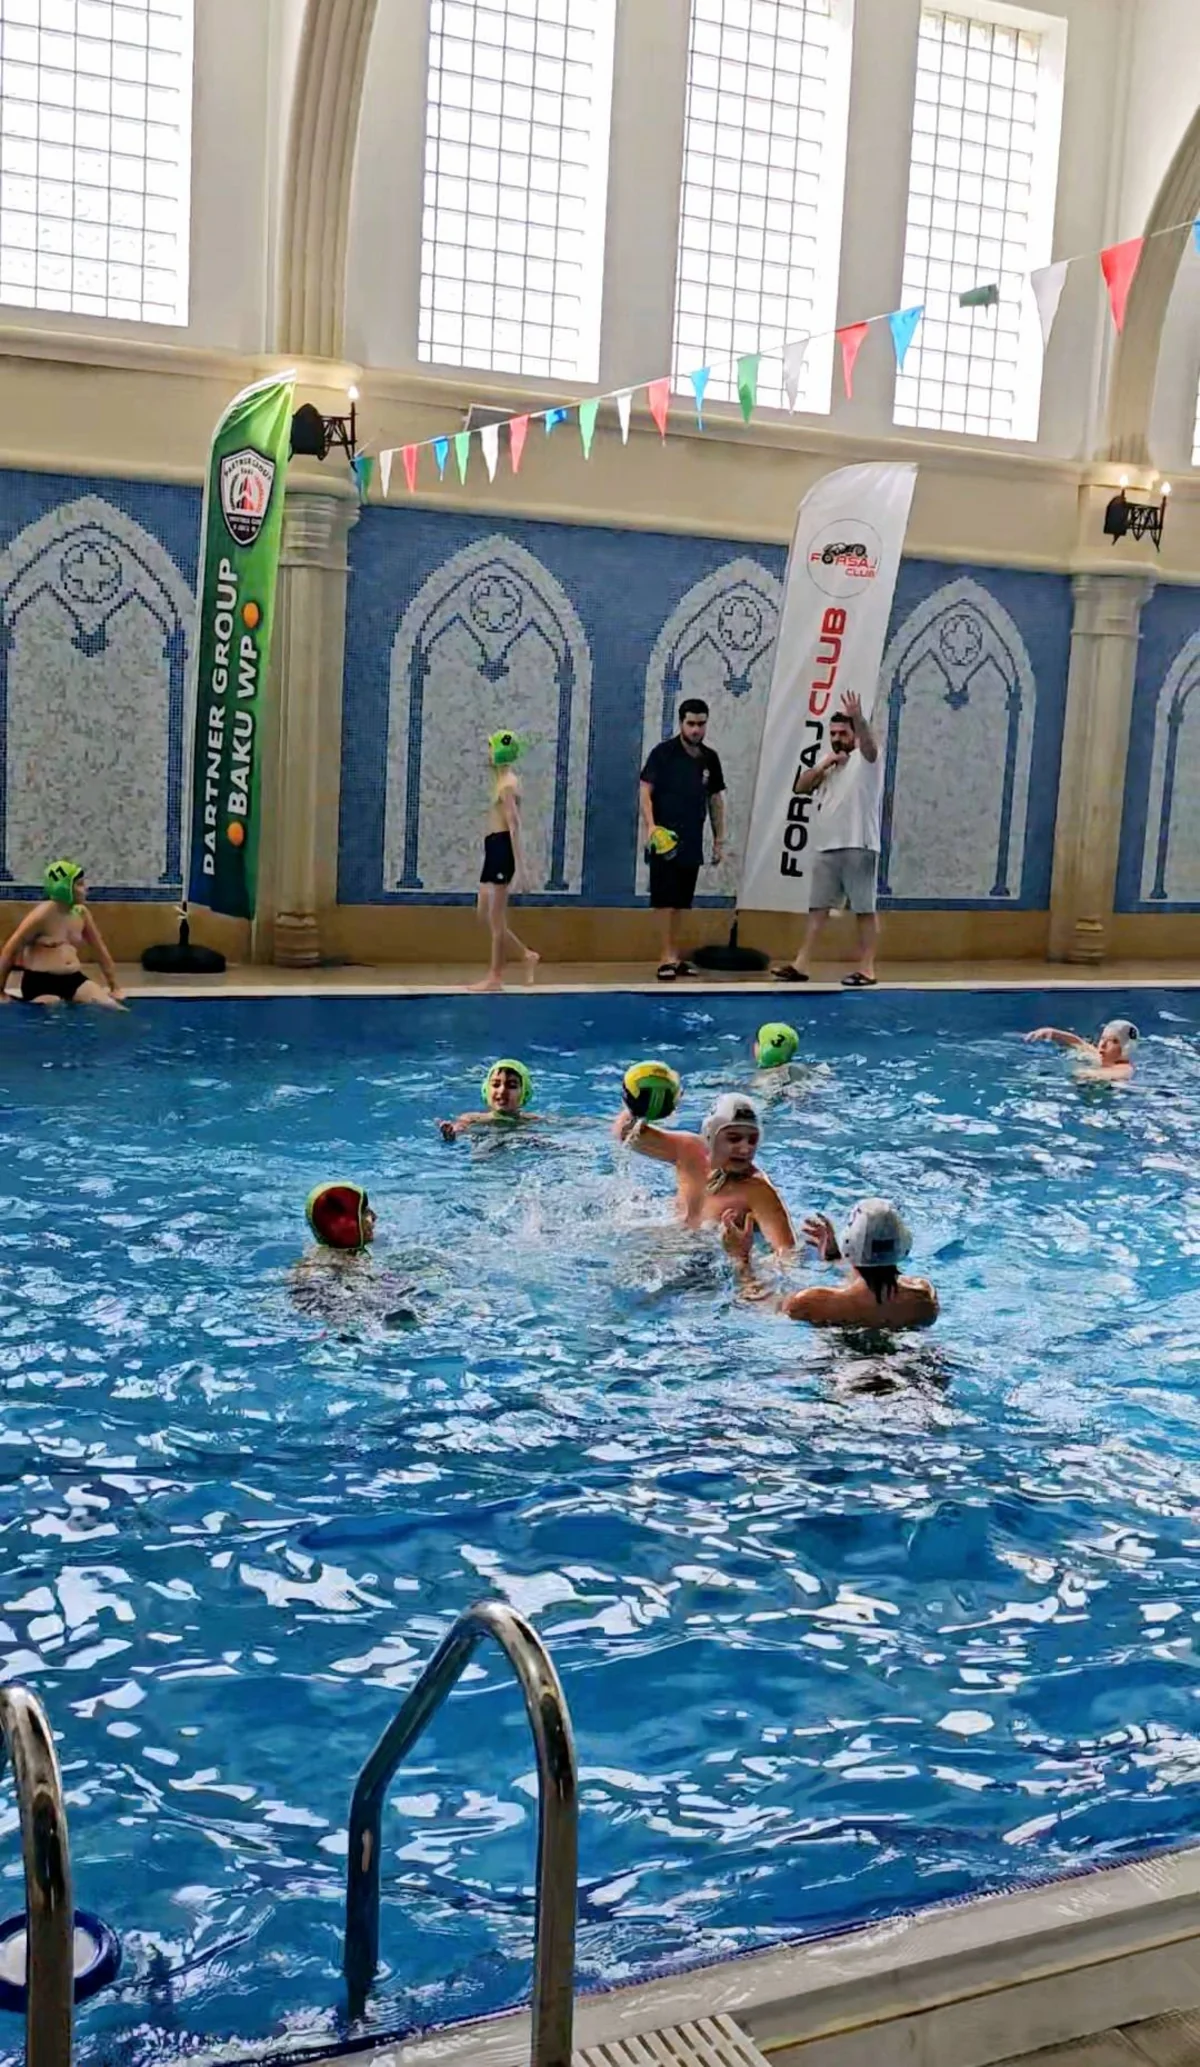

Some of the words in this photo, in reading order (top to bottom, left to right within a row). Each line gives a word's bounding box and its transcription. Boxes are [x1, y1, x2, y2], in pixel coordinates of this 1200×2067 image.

[212, 557, 238, 694] GROUP
[237, 635, 257, 698] WP
[808, 607, 847, 716] CLUB
[203, 705, 226, 876] PARTNER
[227, 710, 253, 816] BAKU
[48, 866, 67, 882] 11
[771, 1034, 785, 1048] 2
